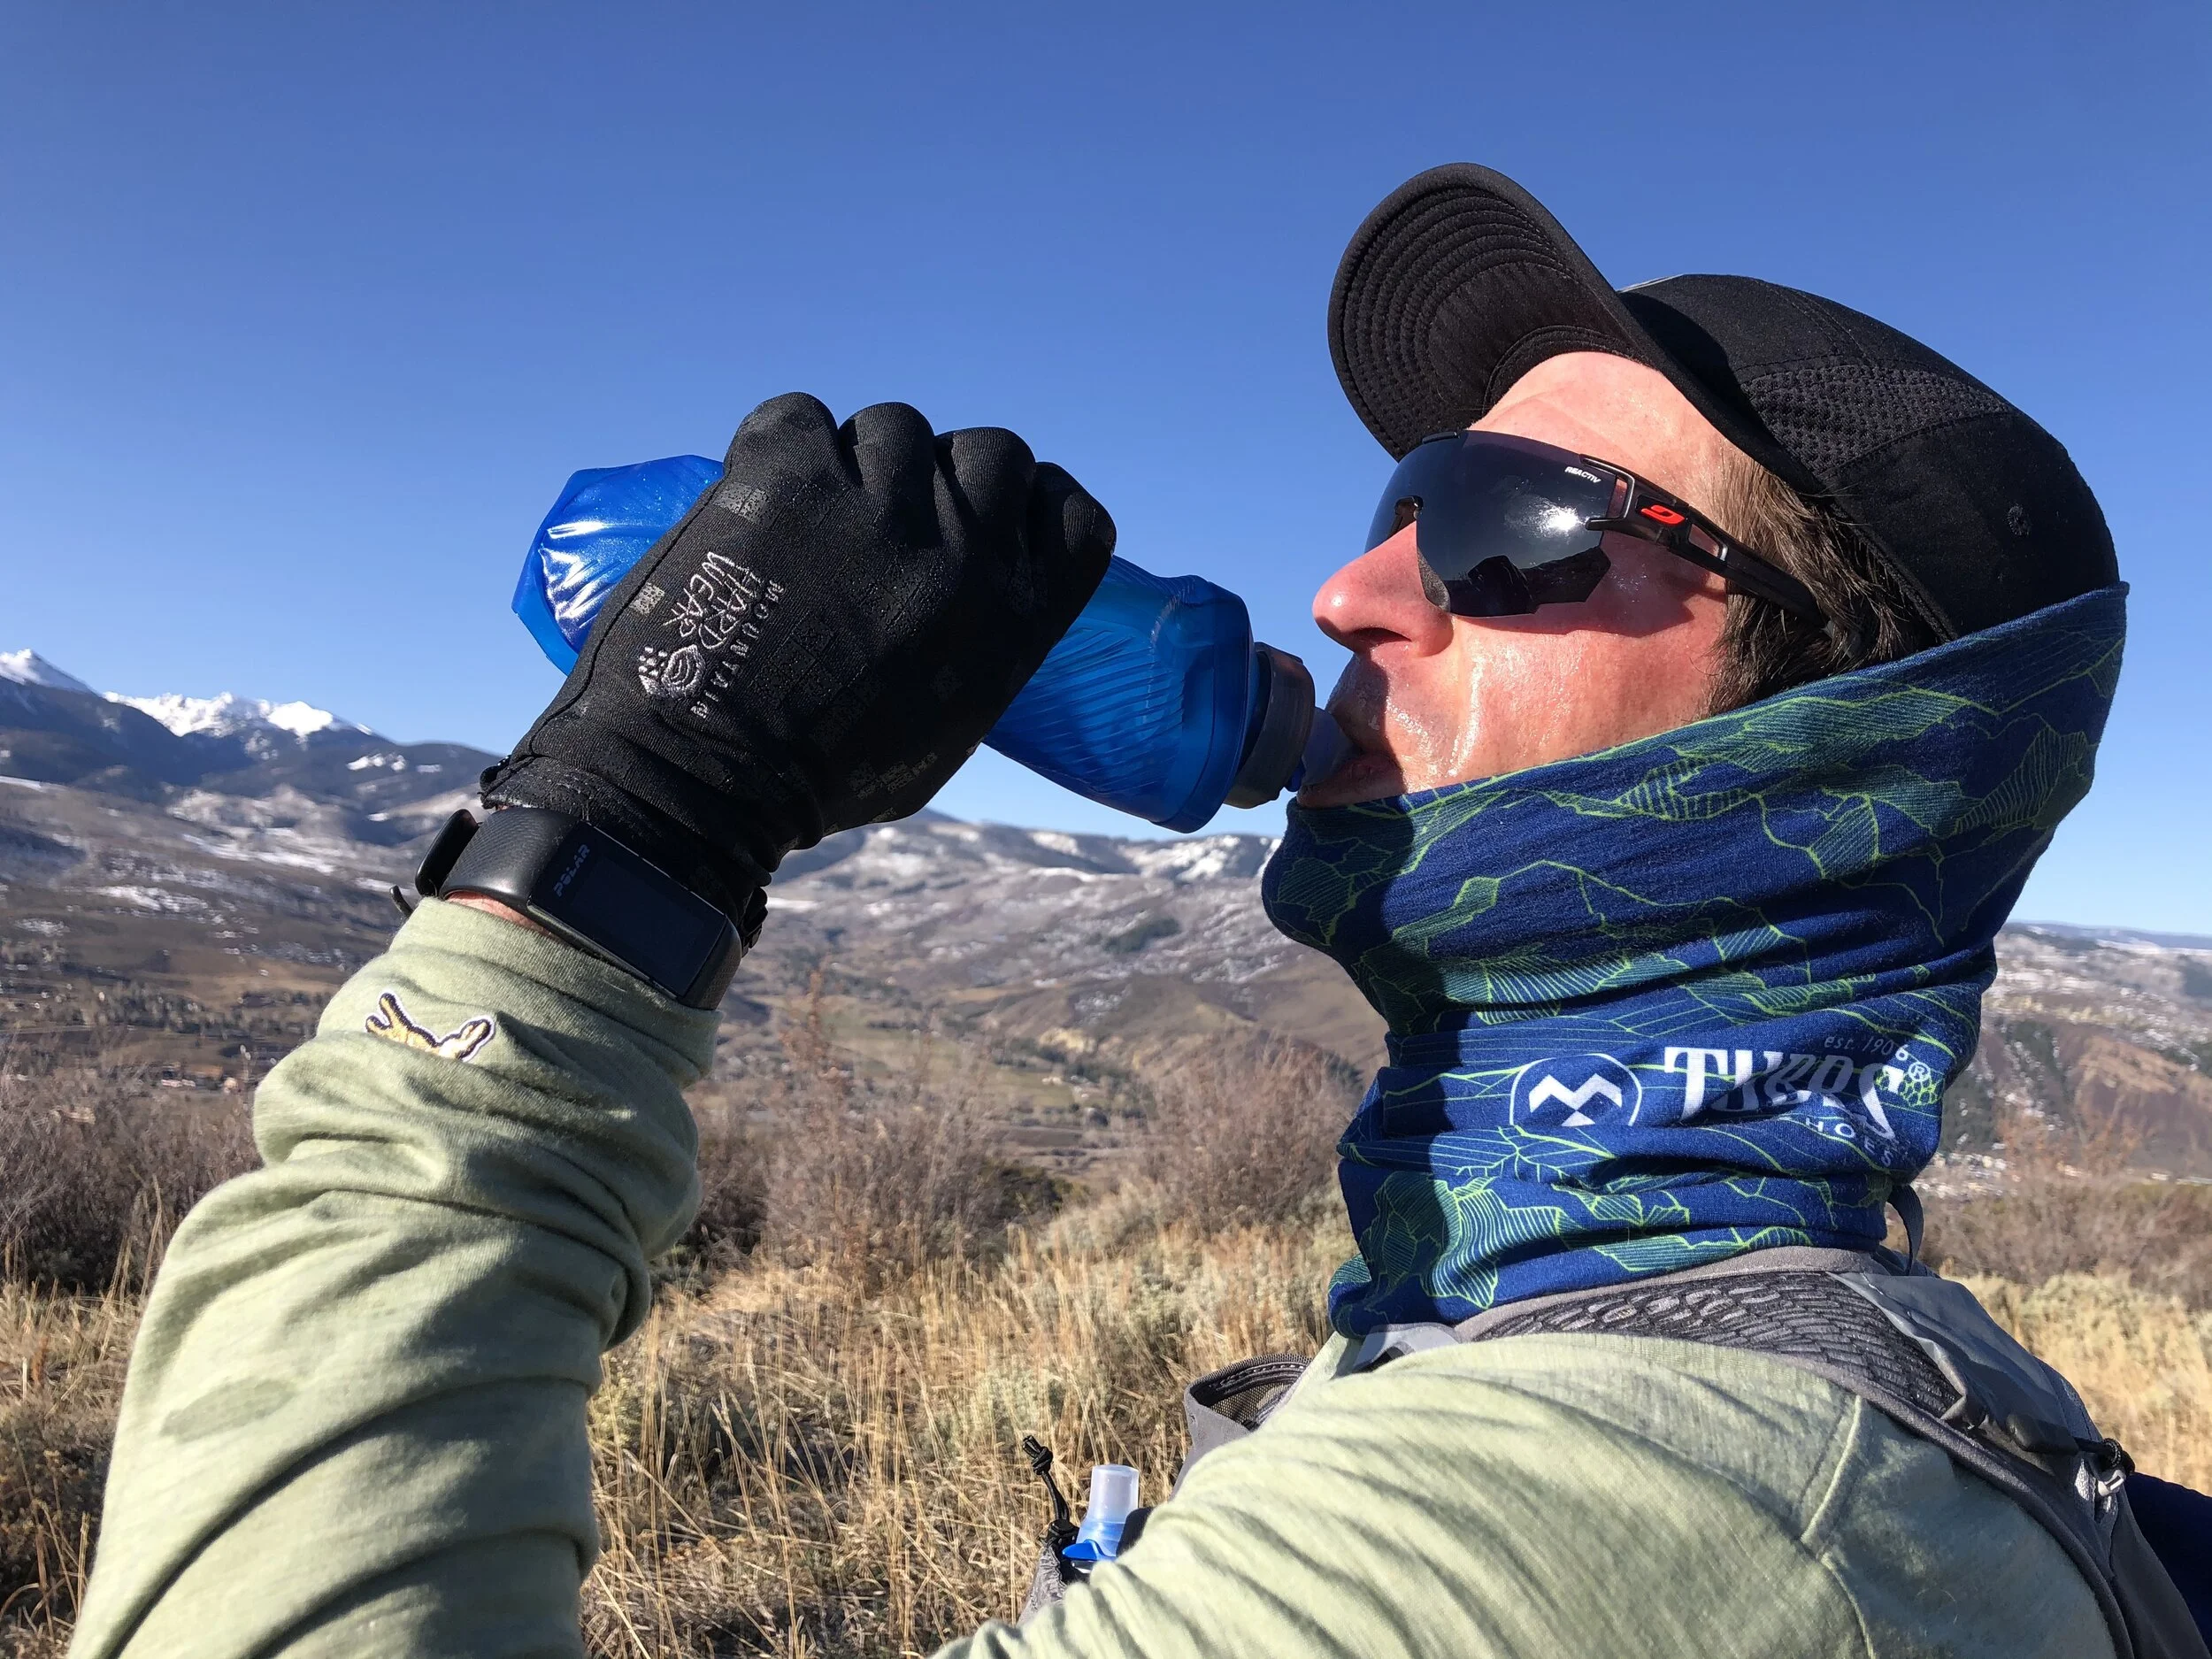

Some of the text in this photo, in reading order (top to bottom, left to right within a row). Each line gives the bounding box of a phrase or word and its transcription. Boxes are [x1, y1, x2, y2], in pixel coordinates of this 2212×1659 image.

[1564, 465, 1601, 483] REACTIV
[663, 551, 751, 638] WEAR
[690, 580, 785, 718] MOUNTAIN
[552, 843, 591, 897] POLAR
[1824, 1034, 1909, 1062] est. 1906
